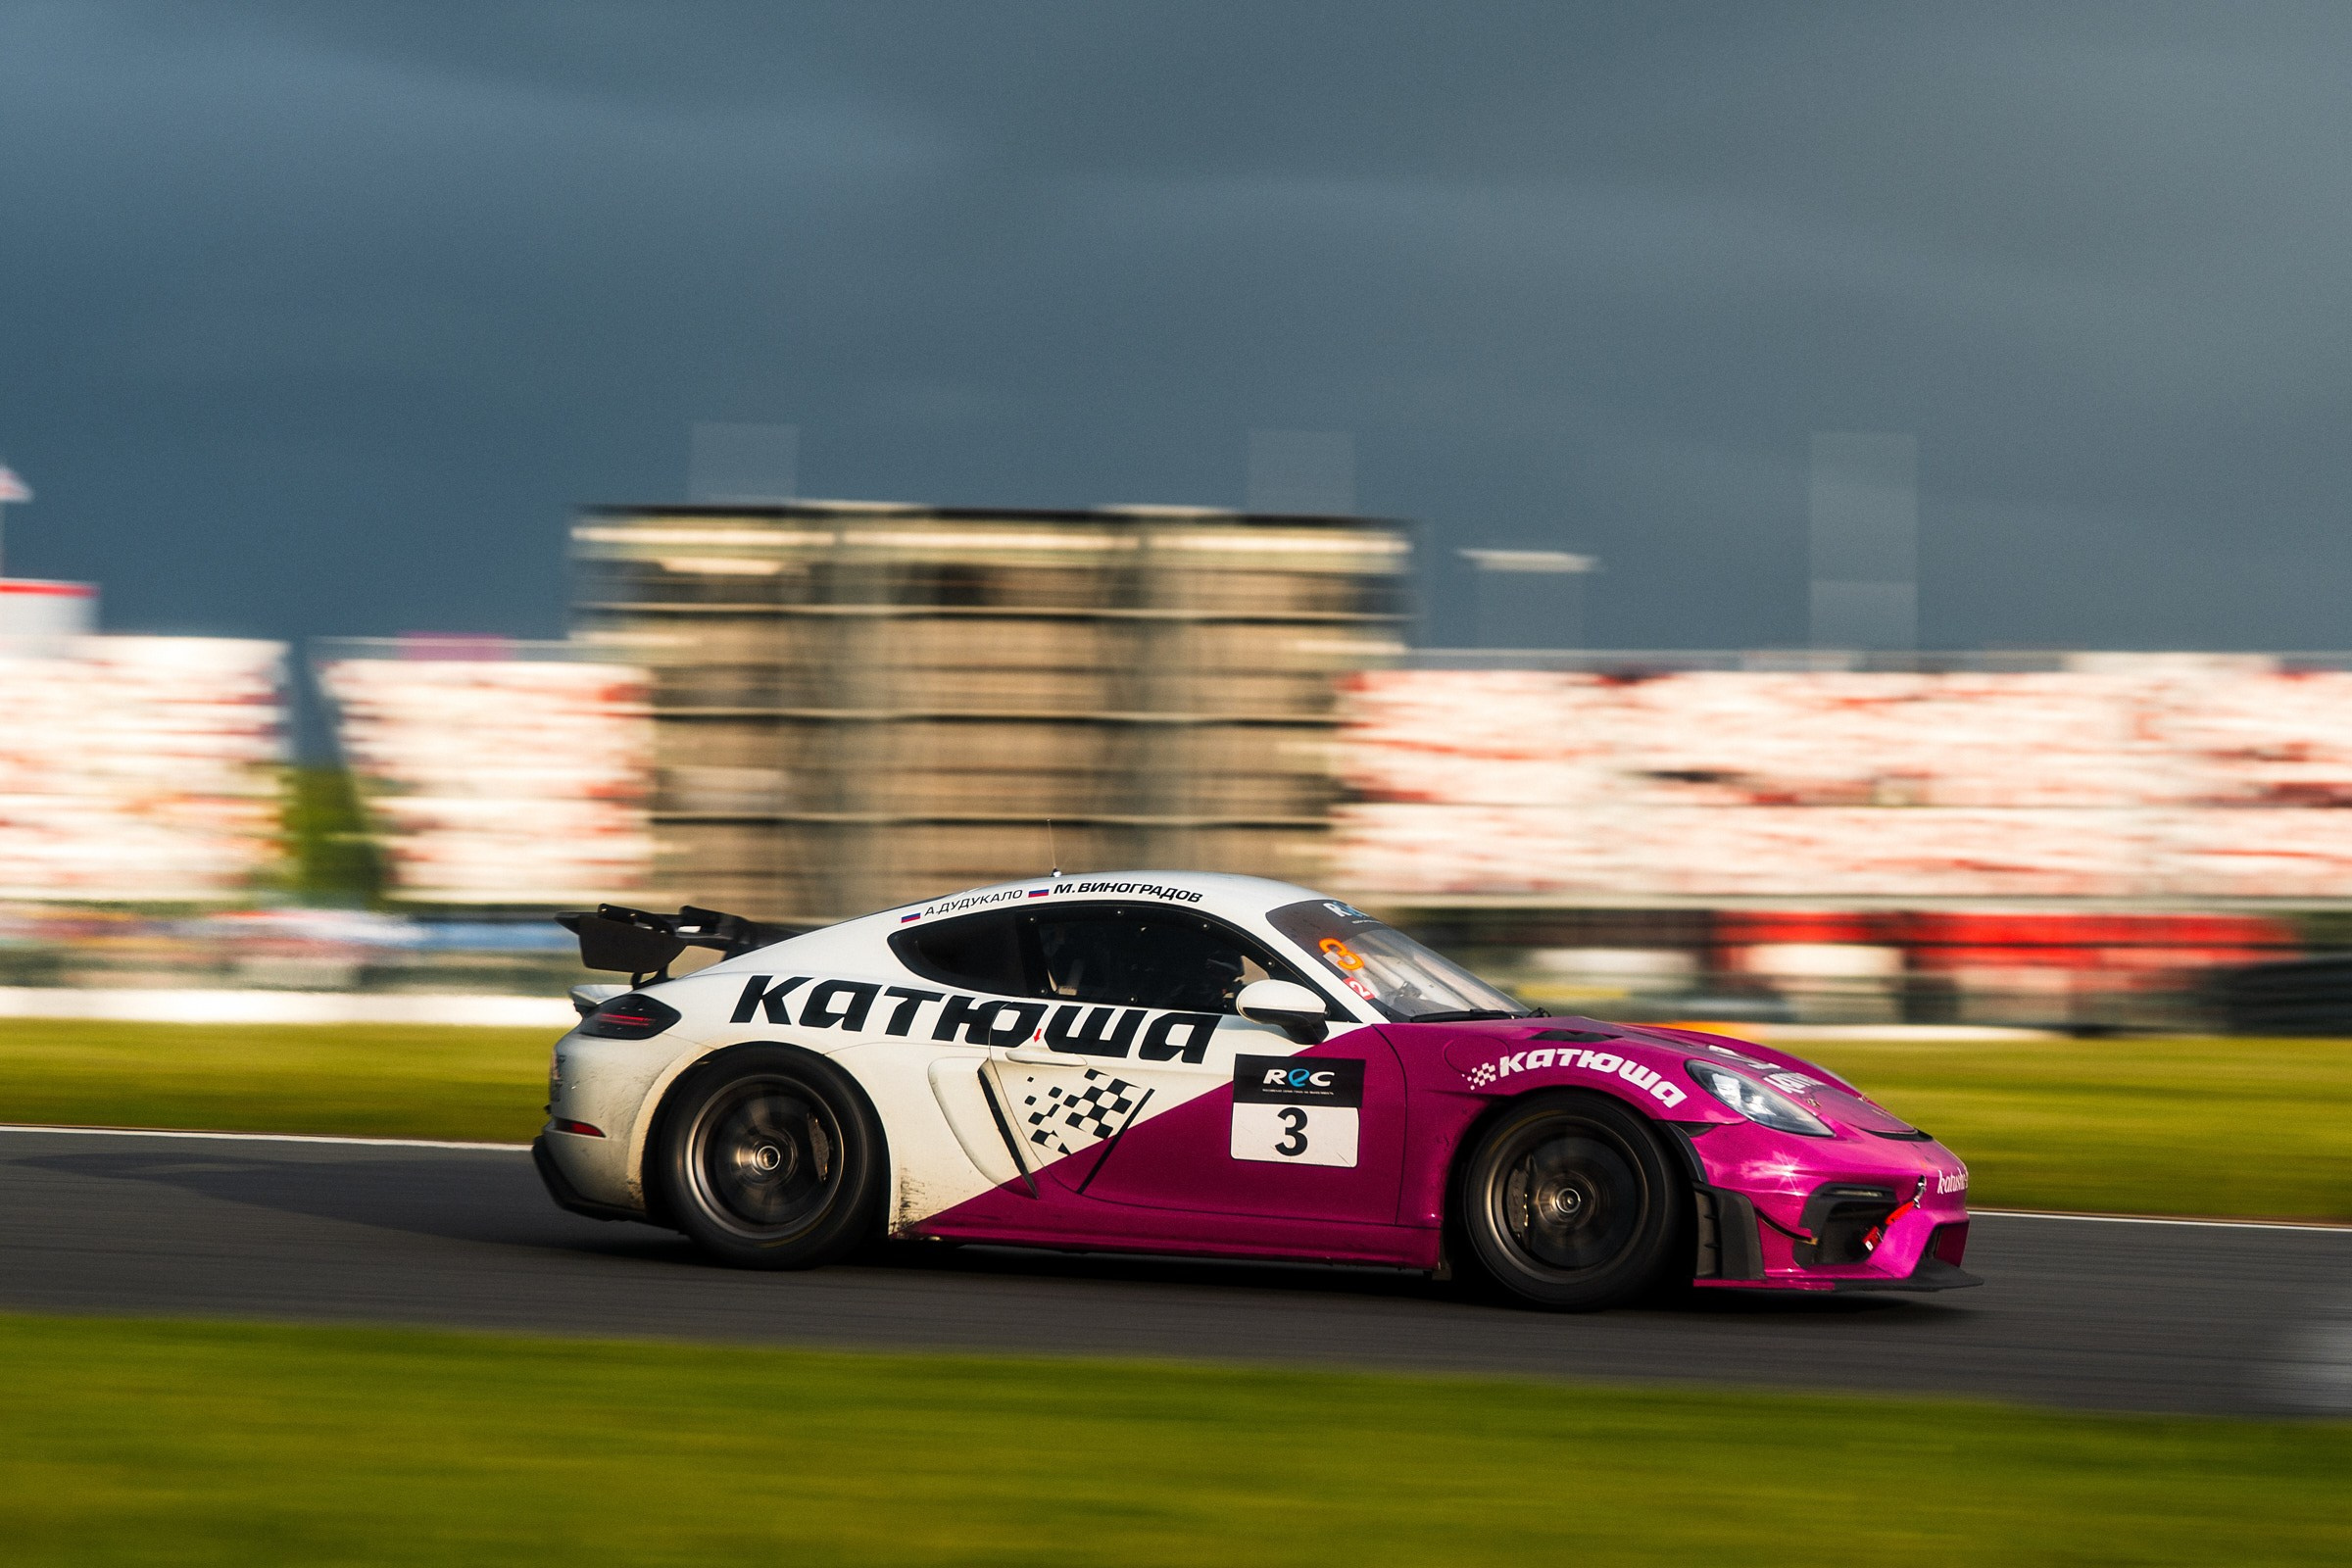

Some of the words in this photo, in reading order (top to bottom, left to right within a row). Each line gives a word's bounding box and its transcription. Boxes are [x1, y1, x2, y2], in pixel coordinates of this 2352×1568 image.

[1318, 938, 1365, 971] 3
[1349, 980, 1371, 998] 2
[1274, 1106, 1308, 1157] 3
